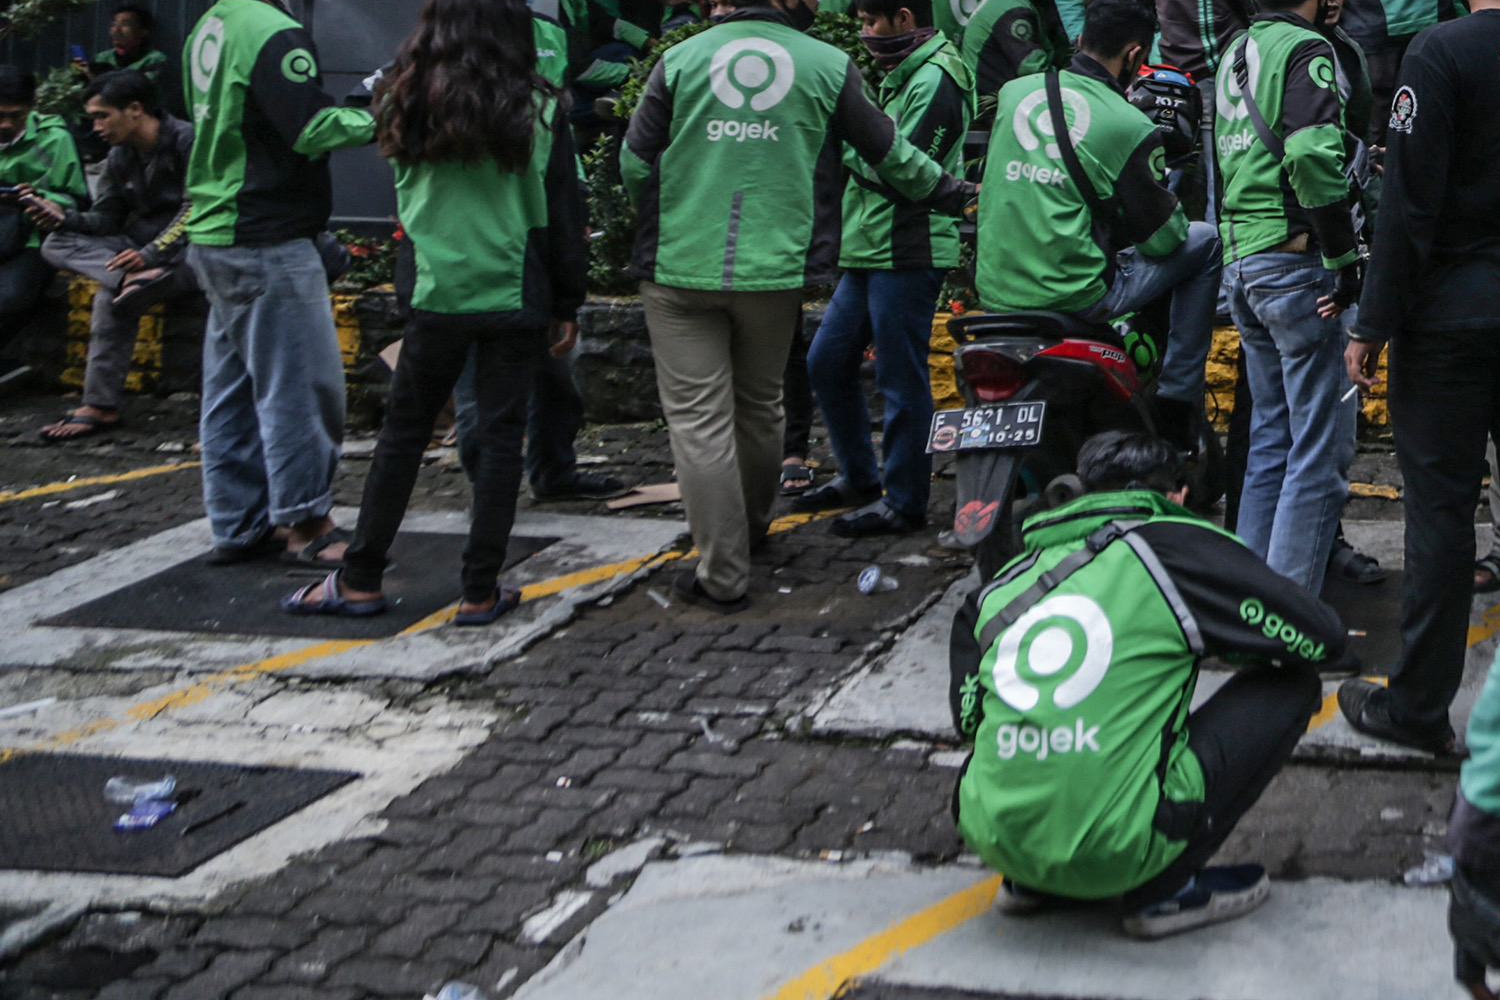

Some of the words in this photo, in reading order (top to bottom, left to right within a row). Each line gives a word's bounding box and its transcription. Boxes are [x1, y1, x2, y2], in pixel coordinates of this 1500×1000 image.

[706, 119, 780, 142] gojek
[926, 125, 947, 159] ojek
[934, 414, 946, 432] F
[1016, 405, 1039, 424] DL
[996, 717, 1100, 761] gojek
